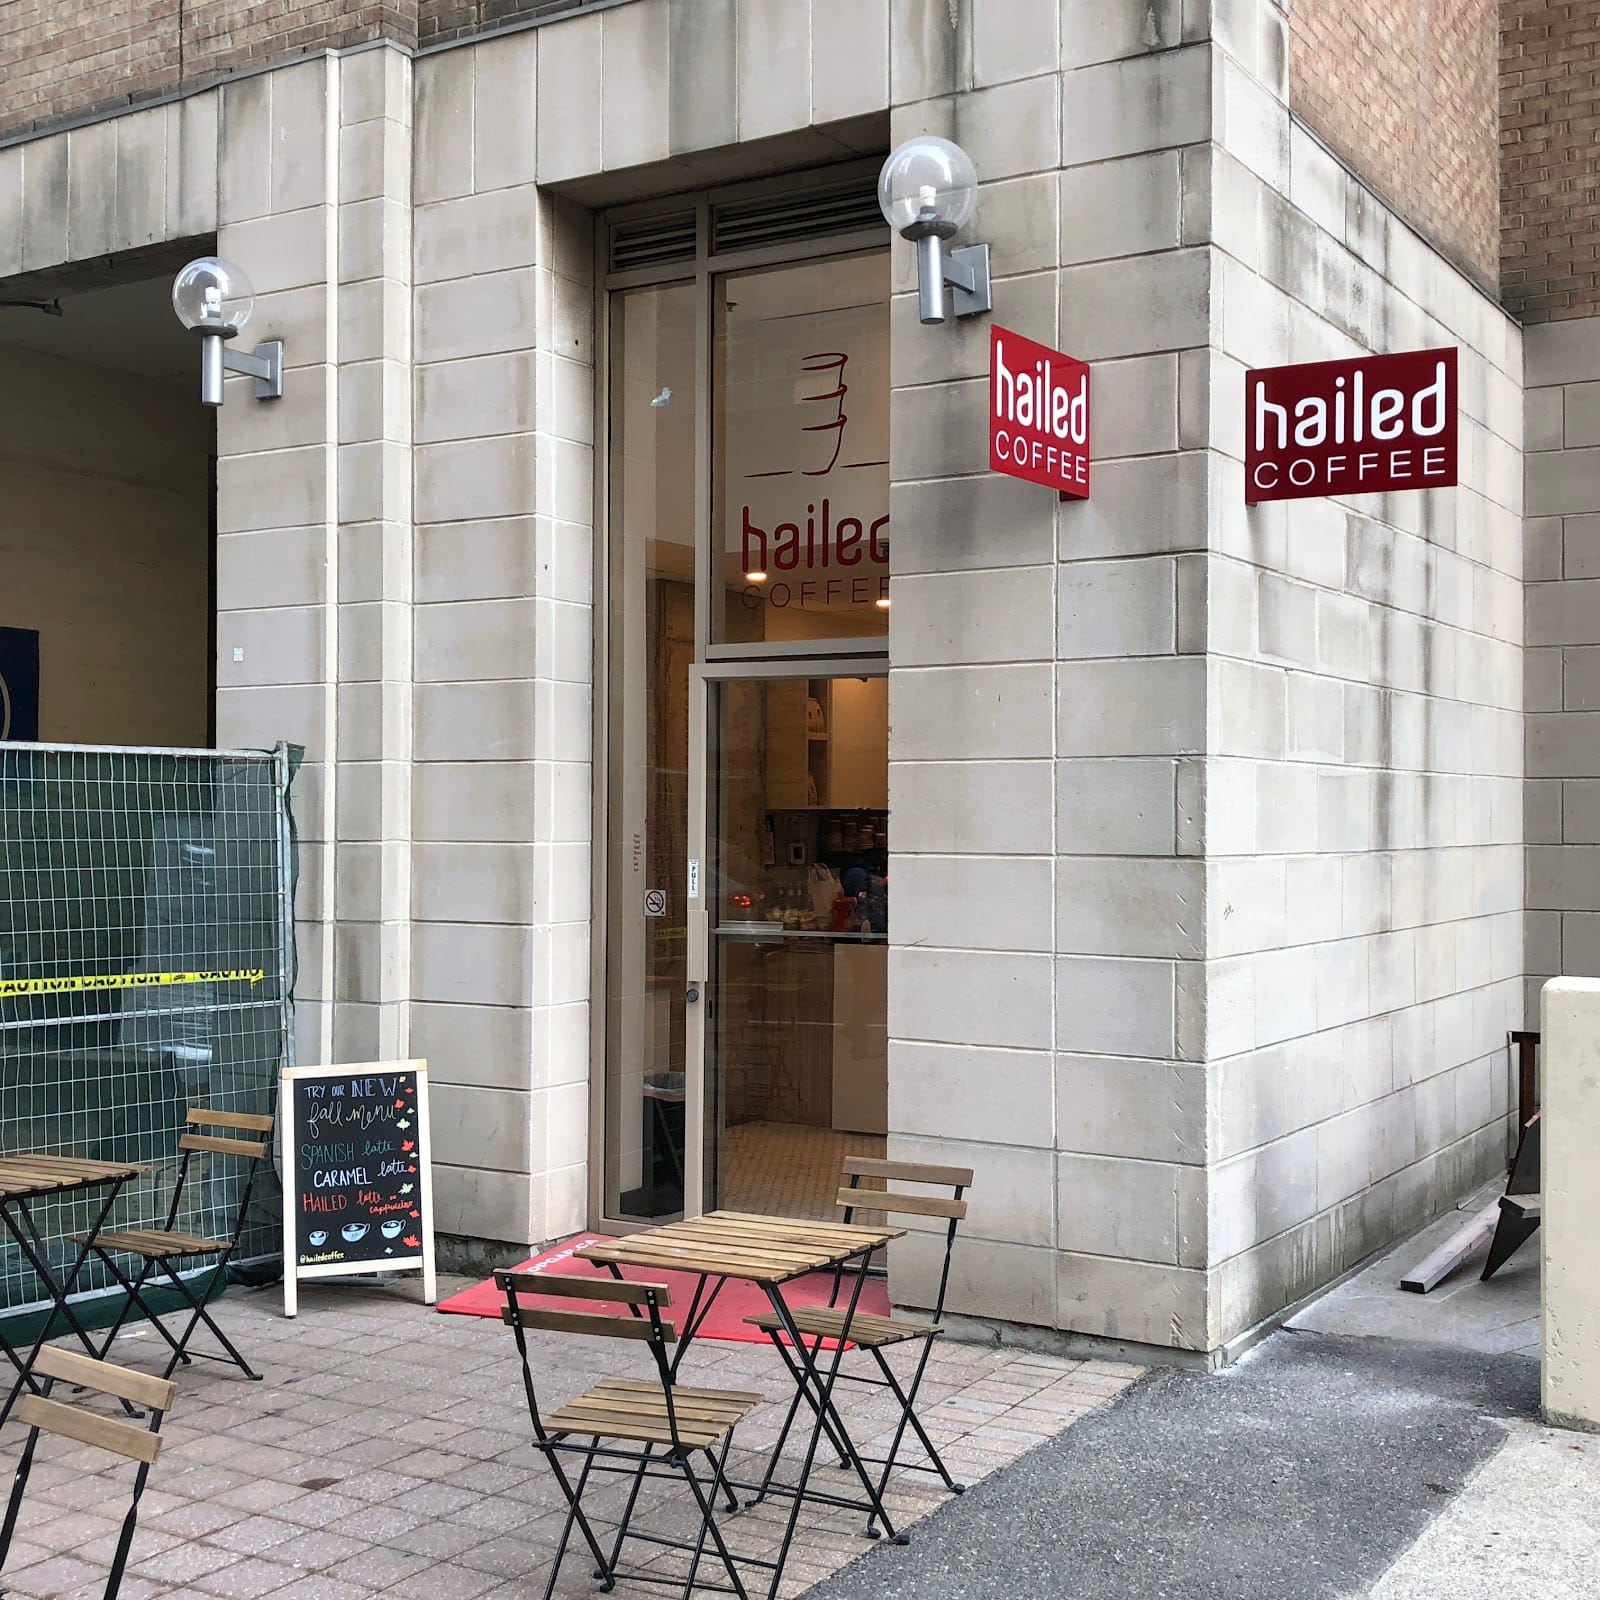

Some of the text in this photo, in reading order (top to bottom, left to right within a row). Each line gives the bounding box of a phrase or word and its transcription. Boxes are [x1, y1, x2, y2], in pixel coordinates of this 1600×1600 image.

[995, 339, 1087, 444] hailed
[1255, 361, 1446, 451] hailed
[995, 429, 1087, 484] COFFEE
[1254, 447, 1446, 489] COFFEE
[0, 980, 76, 992] AUTION
[304, 1078, 399, 1099] TRY OUR NEW
[307, 1101, 397, 1139] fall menu
[300, 1139, 397, 1170] SPANISH latte
[313, 1159, 409, 1188] CARAMEL latte
[303, 1192, 348, 1212] HAILED
[299, 1250, 345, 1264] @hailedcoffee
